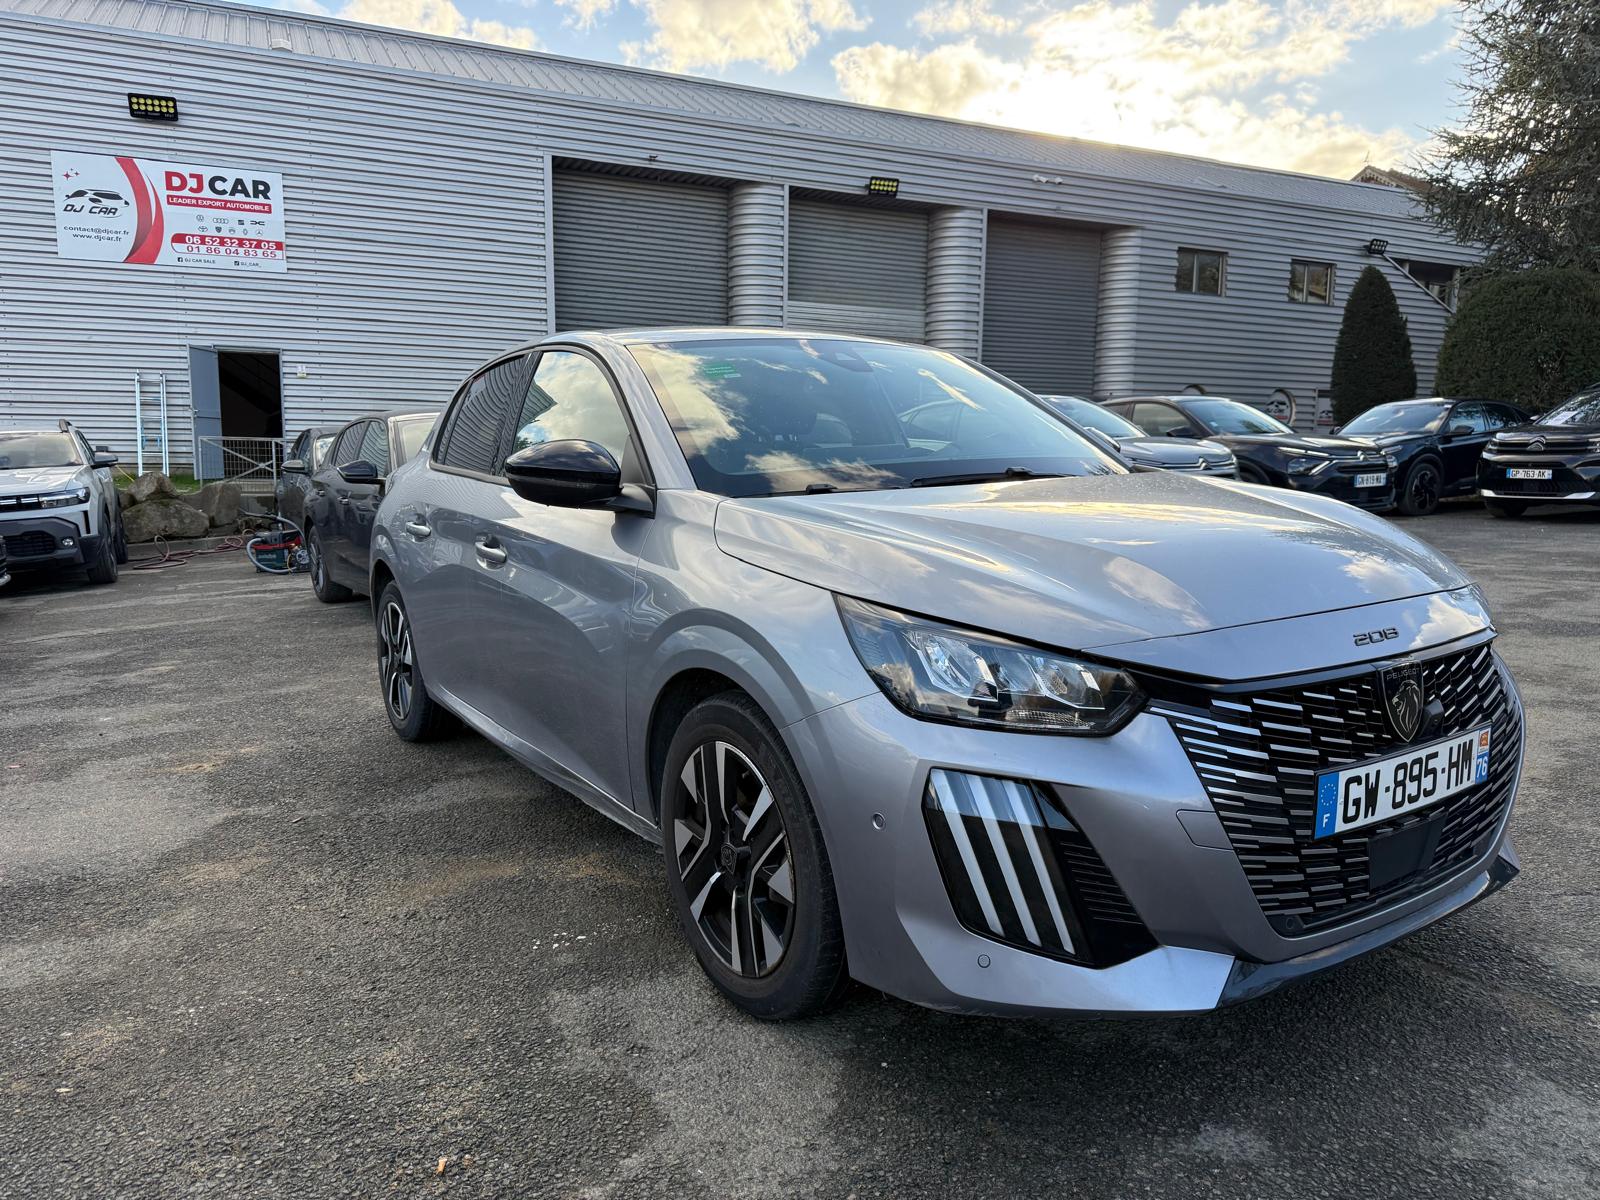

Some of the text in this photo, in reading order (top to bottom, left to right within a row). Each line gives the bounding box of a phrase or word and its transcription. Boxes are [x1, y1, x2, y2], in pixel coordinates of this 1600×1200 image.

[164, 171, 271, 200] DJ CAR
[63, 204, 119, 215] DJ CAR
[169, 197, 270, 211] LEADER EXPORT AUTOMOBILE
[63, 225, 130, 236] contact@djcar.fr
[72, 233, 122, 242] www.djcar.fr
[185, 235, 277, 250] 06 52 32 37 05
[186, 245, 277, 258] 01 86 04 83 65
[1353, 628, 1400, 647] 208
[1476, 756, 1488, 778] 76
[1322, 813, 1330, 828] F
